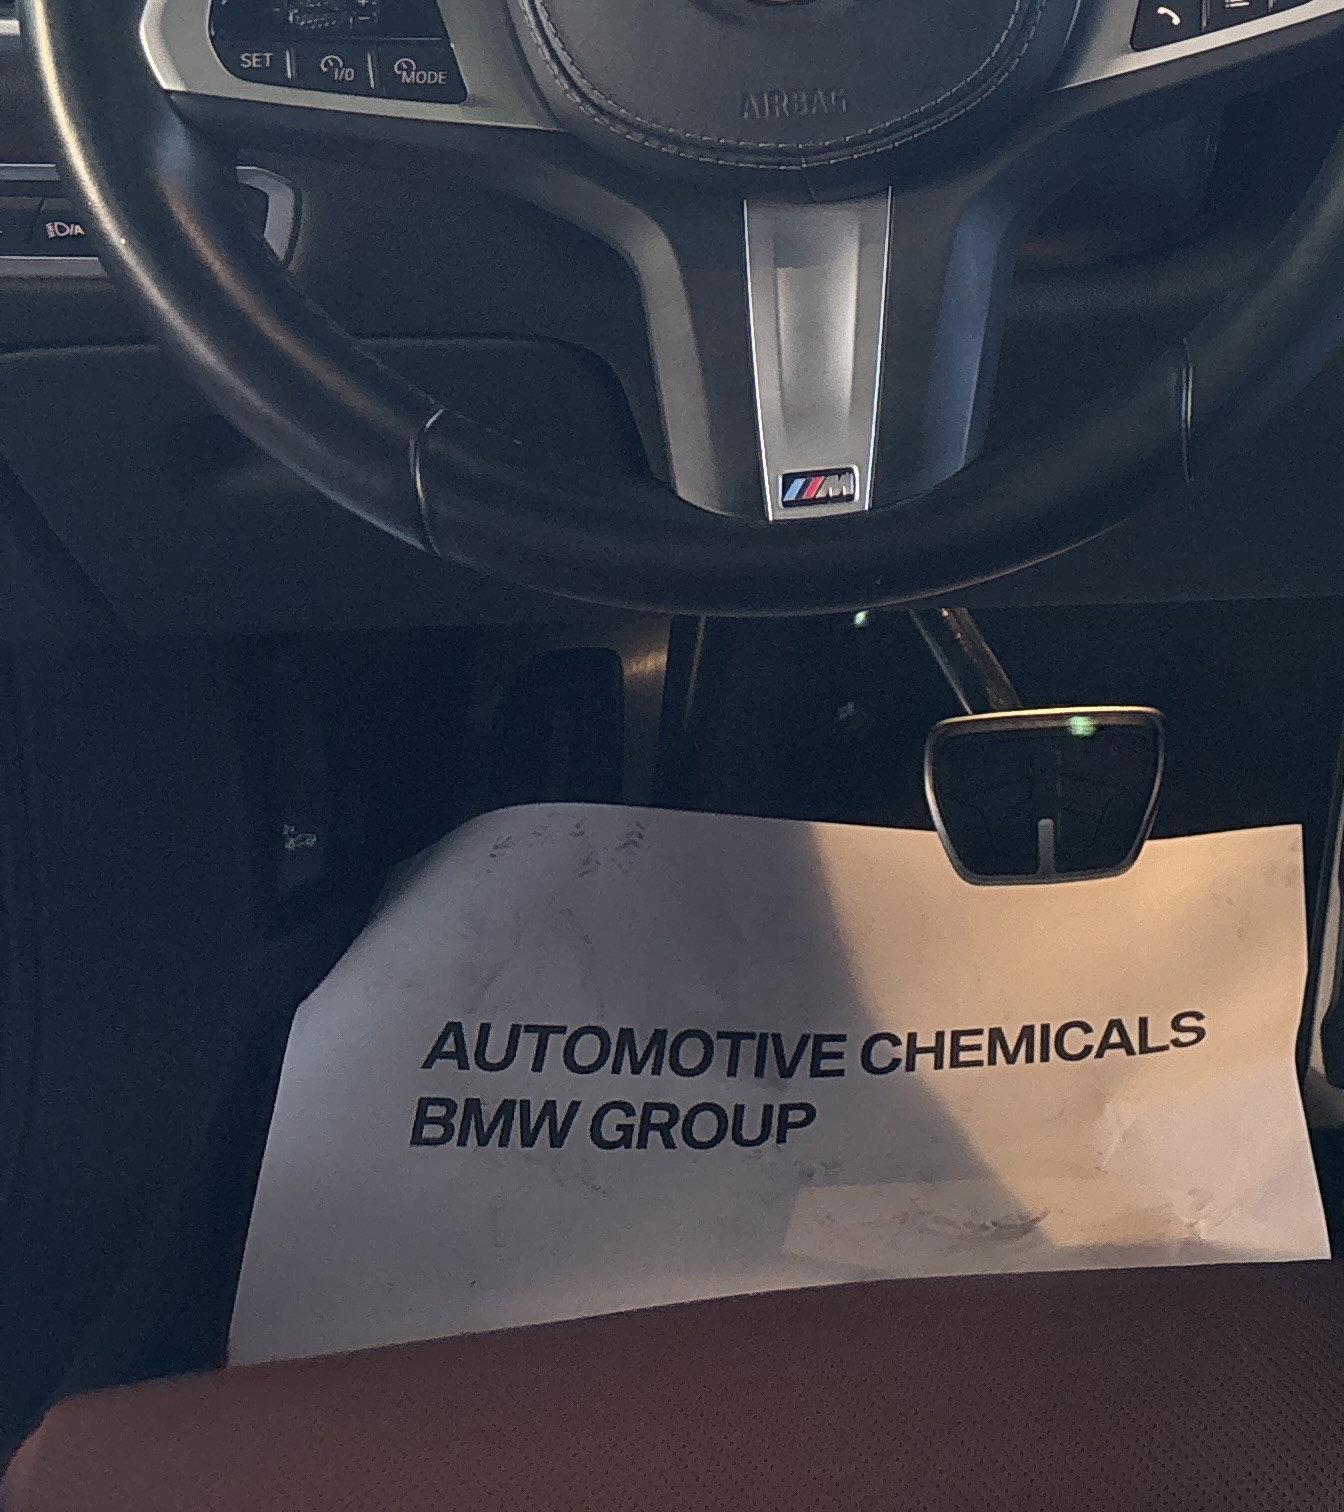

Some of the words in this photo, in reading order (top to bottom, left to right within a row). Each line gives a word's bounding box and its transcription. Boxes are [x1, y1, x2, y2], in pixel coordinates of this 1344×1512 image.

[240, 52, 273, 69] SET
[401, 70, 448, 85] MODE
[742, 89, 849, 120] AIRBAG
[421, 1019, 848, 1080] AUTOMOTIVE
[859, 1009, 1207, 1078] CHEMICALS
[409, 1096, 582, 1149] BMW
[588, 1099, 817, 1152] GROUP
